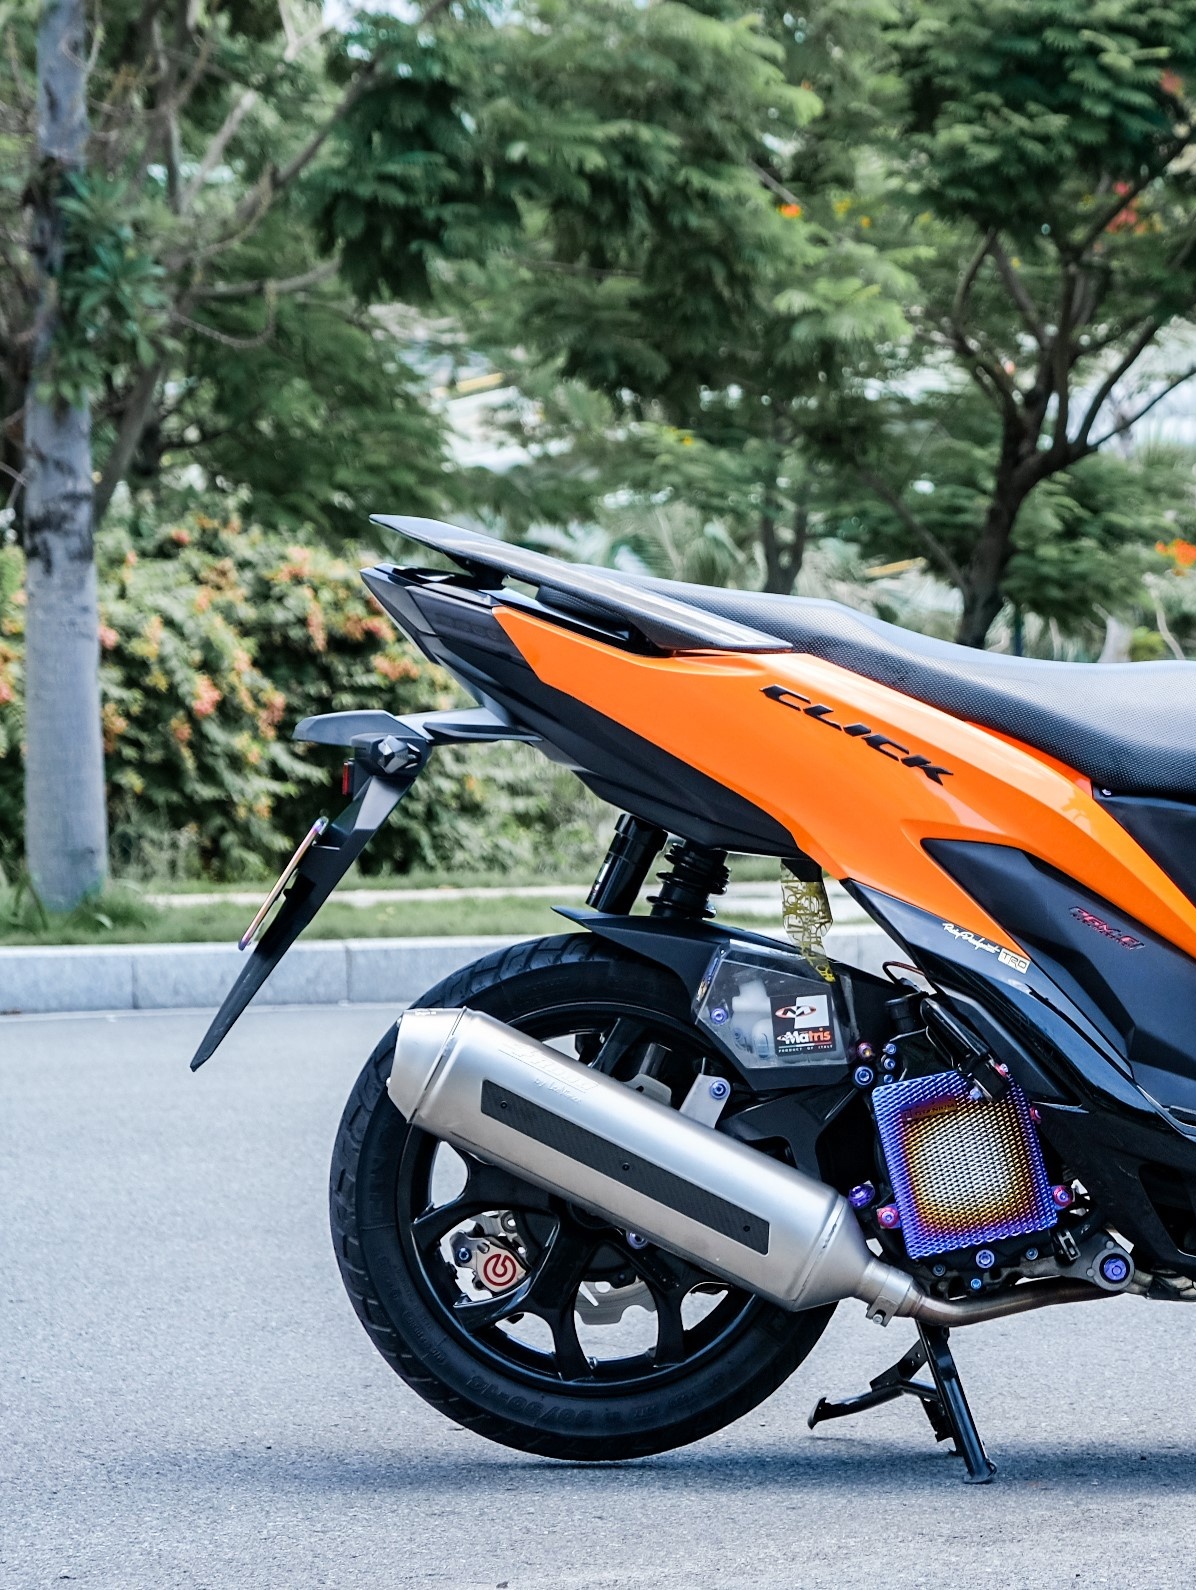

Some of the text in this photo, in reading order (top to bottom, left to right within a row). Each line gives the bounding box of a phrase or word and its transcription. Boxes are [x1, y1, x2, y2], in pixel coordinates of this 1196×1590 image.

[759, 684, 954, 786] CLICK
[1002, 951, 1028, 970] TRD
[784, 1027, 831, 1045] Matris
